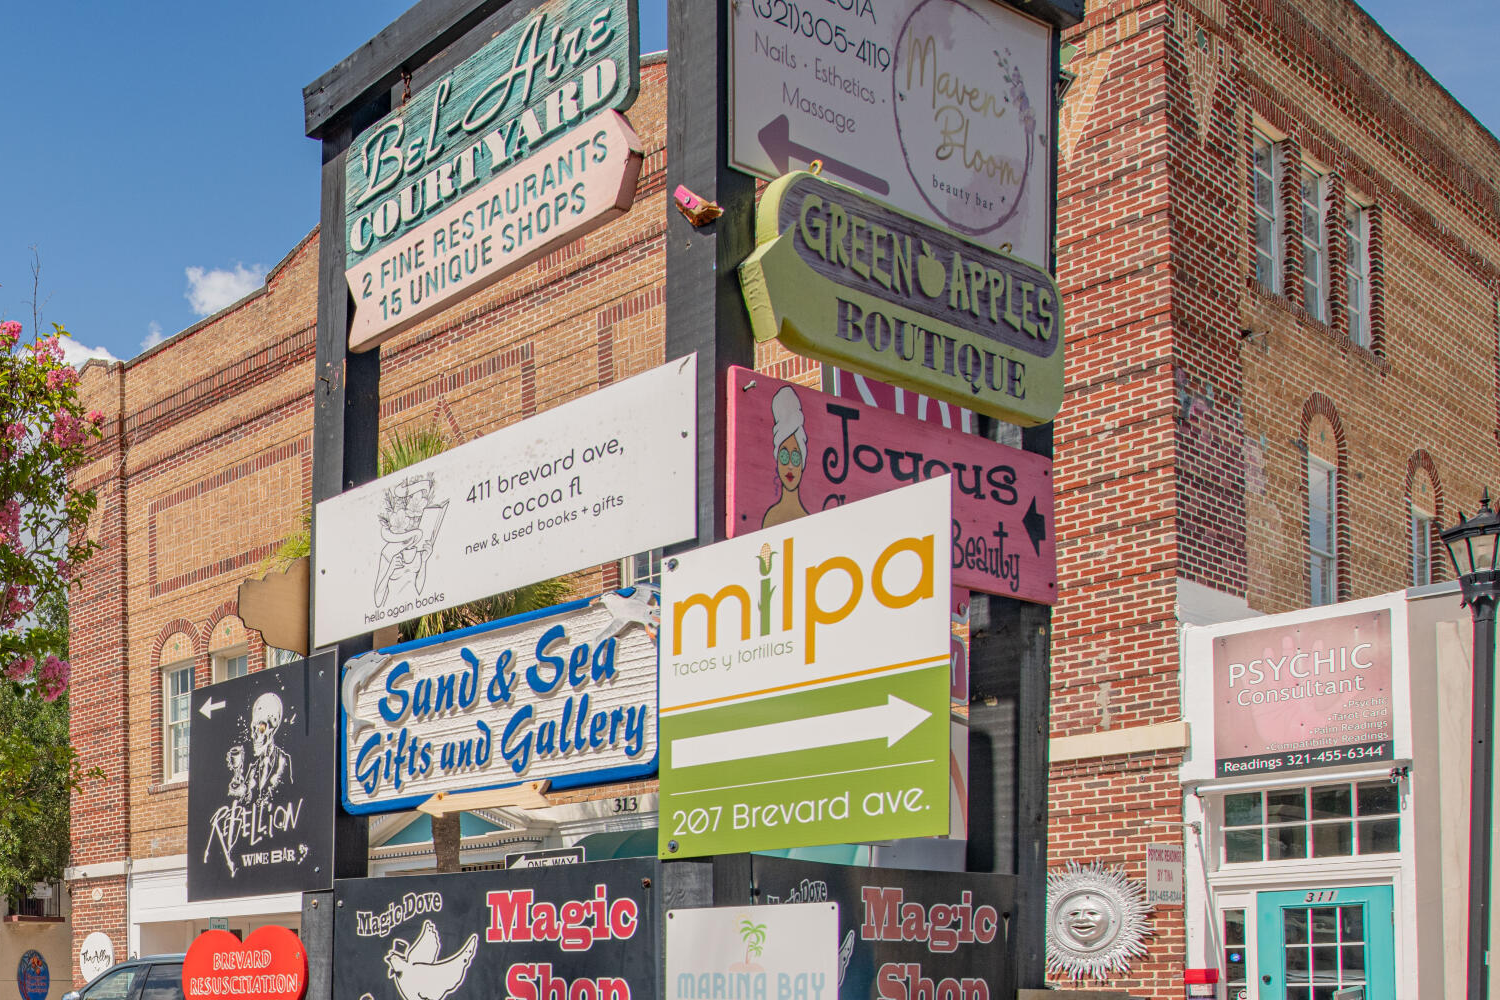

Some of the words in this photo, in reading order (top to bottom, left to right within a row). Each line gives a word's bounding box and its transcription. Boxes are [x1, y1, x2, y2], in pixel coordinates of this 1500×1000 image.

[754, 30, 798, 70] Nails
[814, 57, 876, 106] Esthetics
[906, 26, 1005, 119] Maven
[782, 81, 856, 134] Massage
[350, 59, 618, 252] COURTYARD
[934, 105, 1022, 187] Bloom
[362, 271, 373, 299] 2
[380, 239, 425, 290] FINE
[433, 130, 608, 250] RESTAURANTS
[932, 174, 971, 205] beauty
[975, 191, 995, 211] bar
[379, 292, 403, 321] 15
[409, 236, 493, 306] UNIQUE
[502, 183, 586, 254] SHOPS
[800, 194, 913, 298] GREEN
[949, 251, 1053, 341] APPLES
[836, 296, 1026, 401] BOUTIQUE
[466, 479, 492, 504] 411
[498, 449, 576, 494] brevard
[582, 436, 625, 465] ave,
[502, 490, 563, 520] cocoa
[569, 475, 582, 497] fl
[465, 540, 488, 555] new
[491, 533, 500, 546] &
[503, 522, 533, 542] used
[537, 509, 578, 532] books
[581, 507, 589, 516] +
[593, 494, 624, 517] gifts
[952, 519, 1020, 592] Beauty
[364, 609, 385, 625] hello
[387, 601, 414, 620] again
[415, 591, 445, 611] books
[672, 534, 934, 665] milpa
[378, 648, 479, 722] Sand
[487, 650, 514, 703] &
[526, 625, 616, 693] Sea
[672, 656, 717, 676] Tacos
[722, 654, 732, 671] y
[738, 640, 794, 664] tortillas
[1228, 643, 1373, 688] PSYCHIC
[1237, 675, 1365, 706] Consultant
[1348, 697, 1387, 708] Psychic
[1314, 725, 1337, 734] Palm
[1342, 719, 1387, 732] Readings
[1332, 711, 1358, 721] Tarot
[1363, 708, 1387, 718] Card
[355, 728, 430, 795] Gifts
[440, 720, 490, 770] and
[501, 693, 646, 774] Gallery
[1224, 757, 1282, 772] Readings
[1287, 745, 1383, 766] 321-455-6344
[1271, 737, 1337, 750] Compatibility
[1342, 731, 1388, 742] Readings
[613, 797, 638, 812] 313
[672, 806, 723, 836] 207
[732, 791, 850, 830] Brevard
[862, 787, 931, 817] ave.
[241, 851, 269, 867] WINE
[271, 848, 296, 866] BAR
[357, 903, 403, 937] Magic
[403, 891, 442, 922] Dove
[486, 884, 638, 951] Magic
[861, 885, 997, 952] Magic
[1305, 891, 1336, 903] 311
[213, 949, 272, 971] BREVARD
[190, 973, 298, 996] RESUSCITATION
[677, 971, 767, 1000] MARINA
